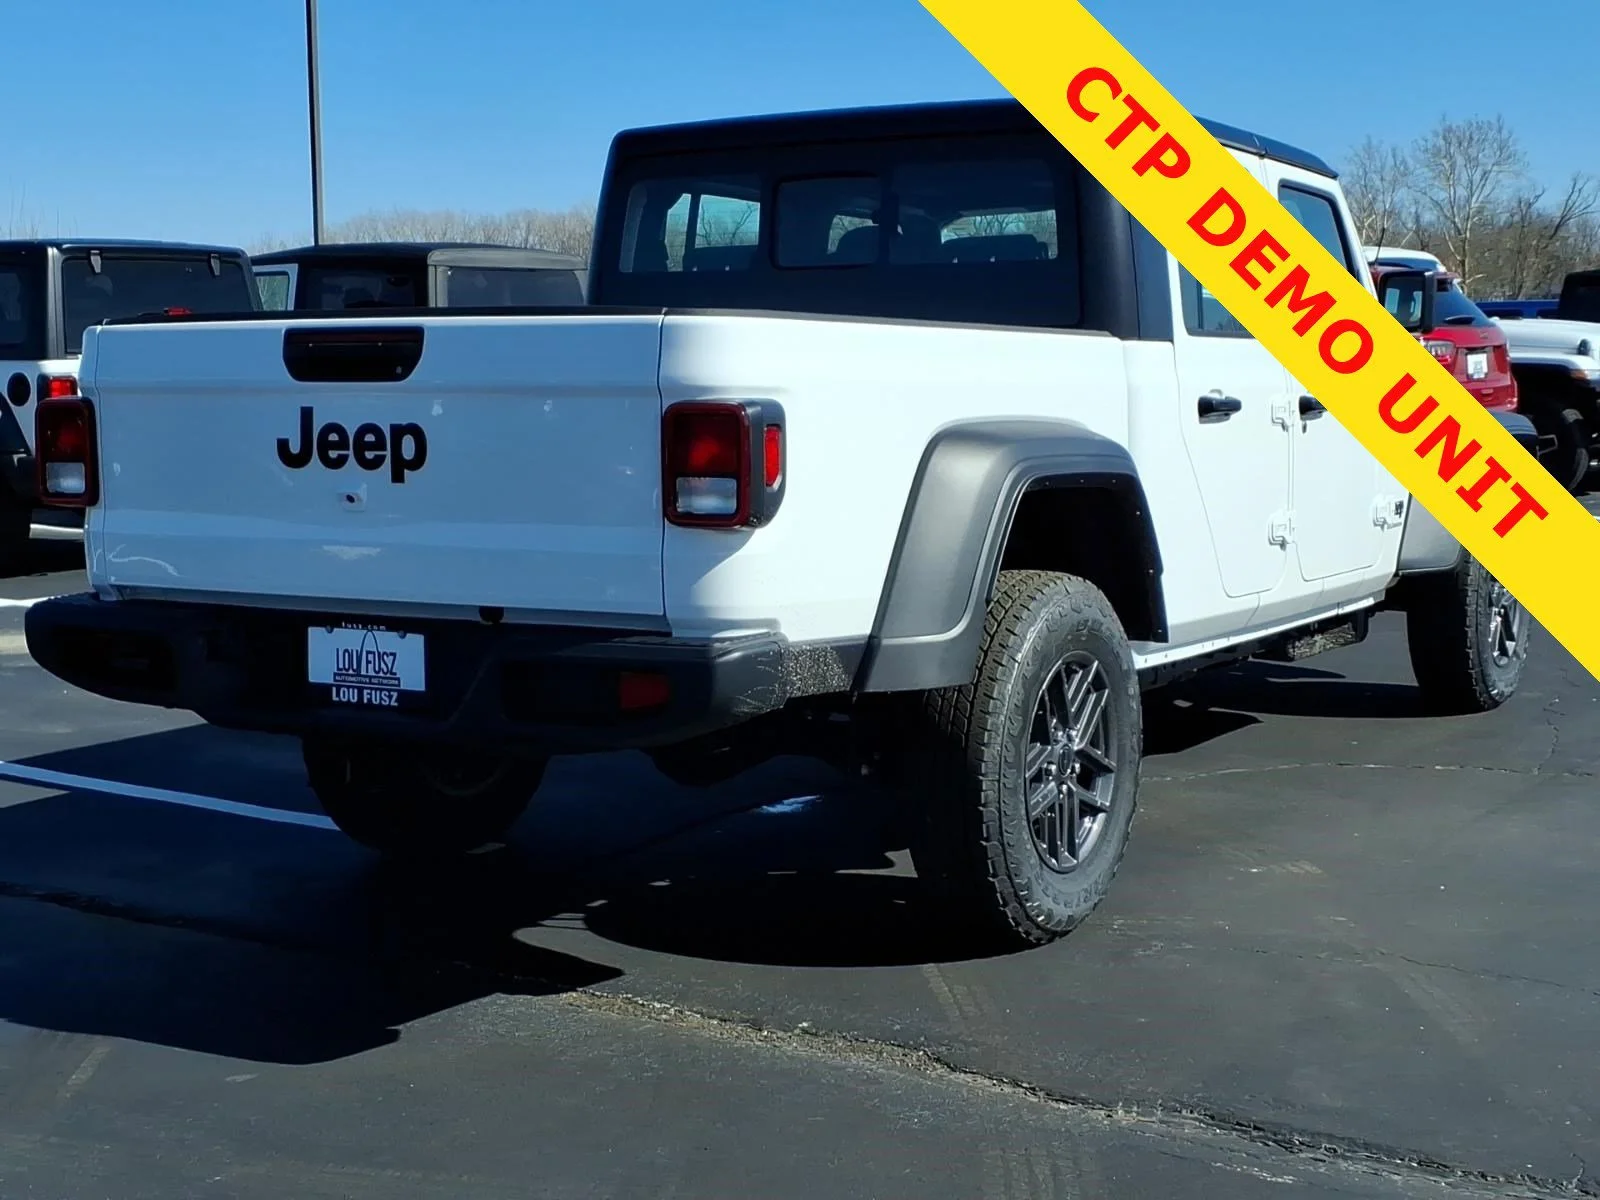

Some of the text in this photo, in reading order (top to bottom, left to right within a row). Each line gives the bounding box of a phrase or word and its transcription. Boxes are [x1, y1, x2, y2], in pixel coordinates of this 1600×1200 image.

[276, 406, 428, 484] Jeep
[336, 647, 397, 676] LOU FUSZ
[332, 686, 399, 707] LOU FUSZ
